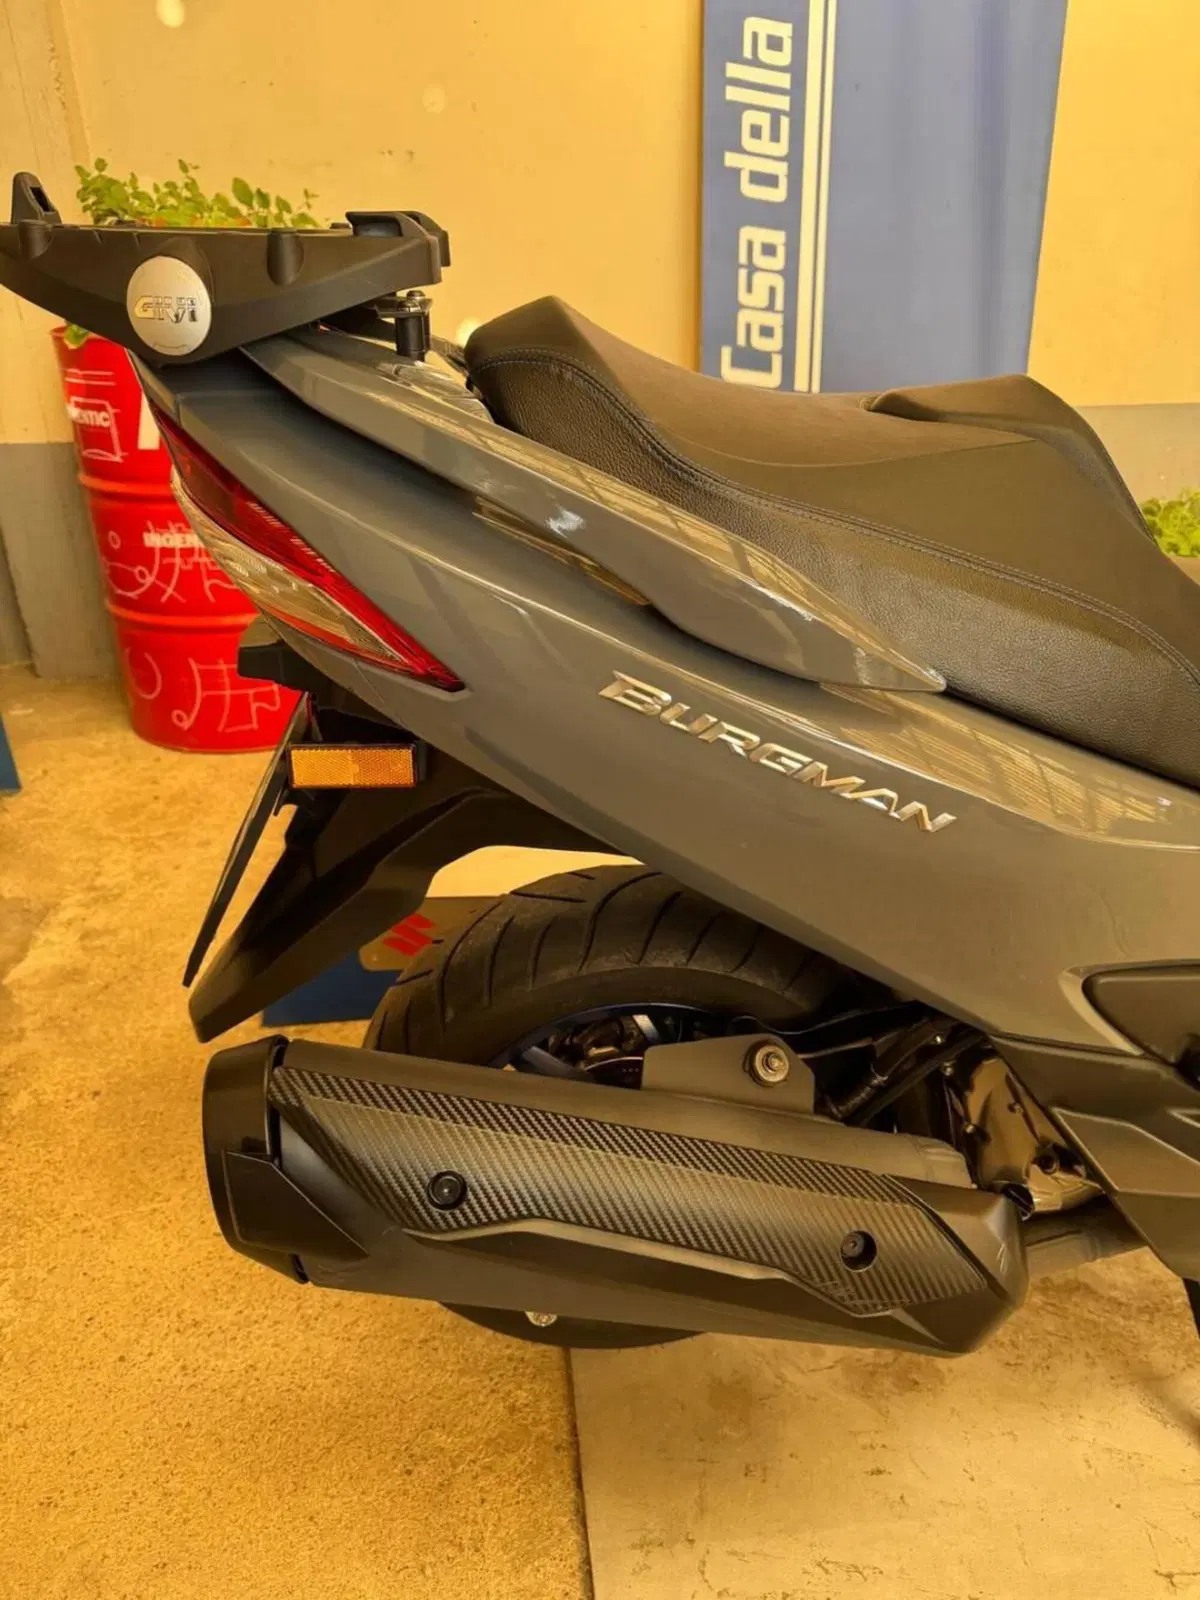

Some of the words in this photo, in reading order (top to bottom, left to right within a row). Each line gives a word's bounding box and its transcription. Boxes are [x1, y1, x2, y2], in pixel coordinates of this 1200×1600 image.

[724, 16, 793, 203] della
[134, 295, 198, 323] GIVI
[720, 225, 787, 389] Casa
[598, 670, 957, 832] BURGMAN
